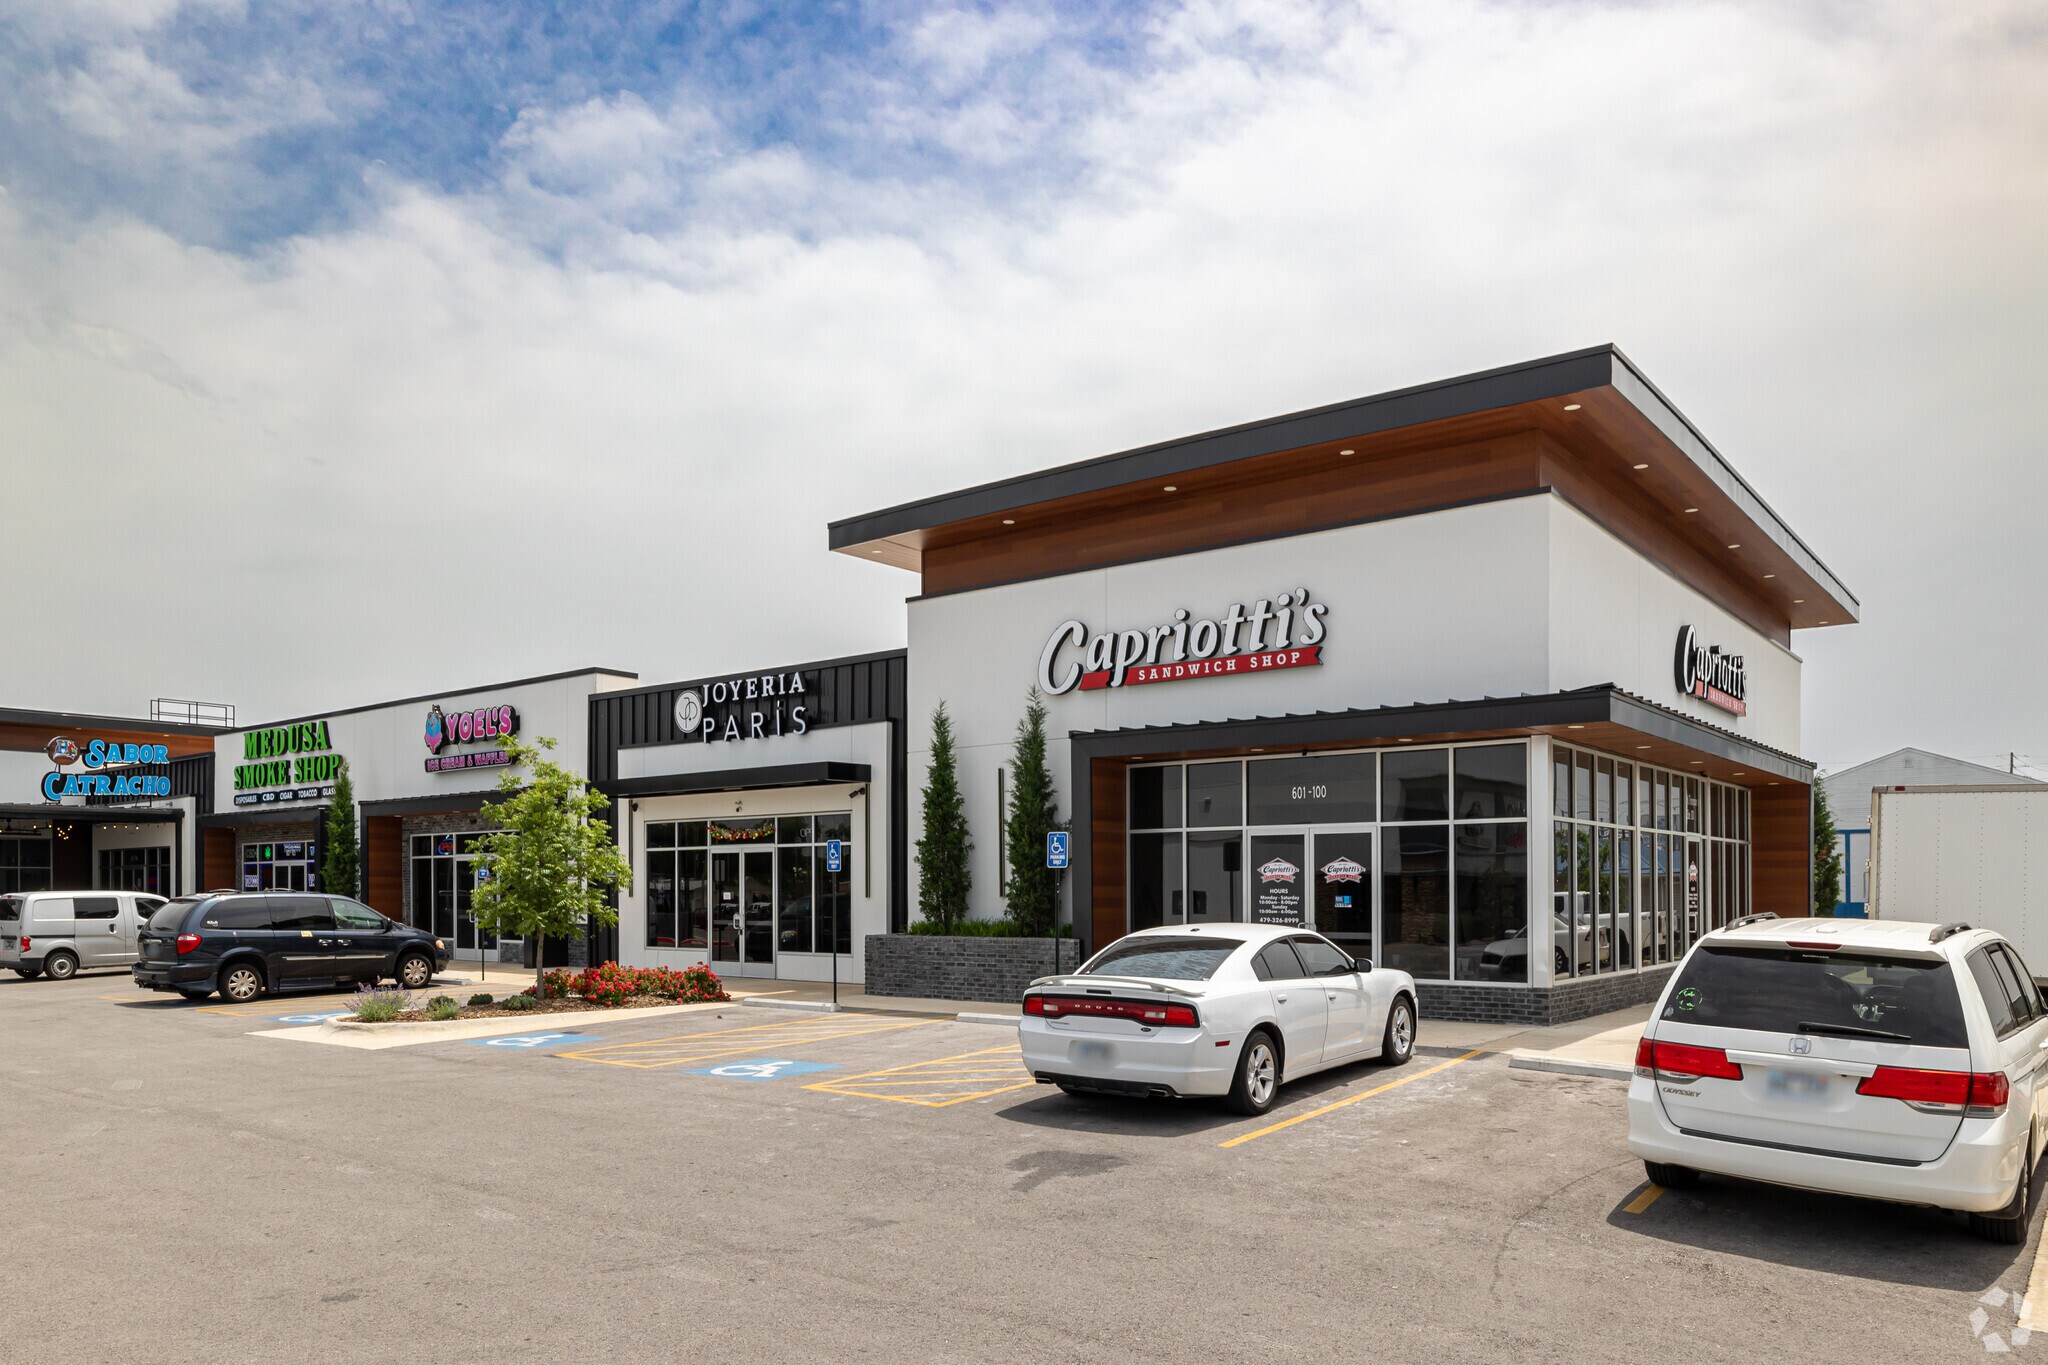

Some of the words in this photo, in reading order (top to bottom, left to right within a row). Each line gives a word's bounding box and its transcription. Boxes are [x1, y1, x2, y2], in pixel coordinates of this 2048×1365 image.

[1038, 587, 1329, 696] Capriotti's
[1138, 659, 1237, 681] SANDWICH
[1250, 651, 1301, 669] SHOP
[702, 671, 805, 708] JOYERIA
[445, 705, 512, 741] YOEL'S
[85, 739, 170, 768] SABOR
[242, 720, 330, 761] MEDUSA
[233, 760, 289, 791] SMOKE
[293, 754, 340, 784] SHOP
[427, 758, 439, 772] ICE
[441, 754, 466, 770] CREAM
[44, 772, 172, 801] CATRACHO
[262, 793, 275, 801] CBD
[279, 791, 294, 800] CIGAR
[1074, 1003, 1125, 1011] DODGE
[1662, 1087, 1702, 1097] ODYSSEY
